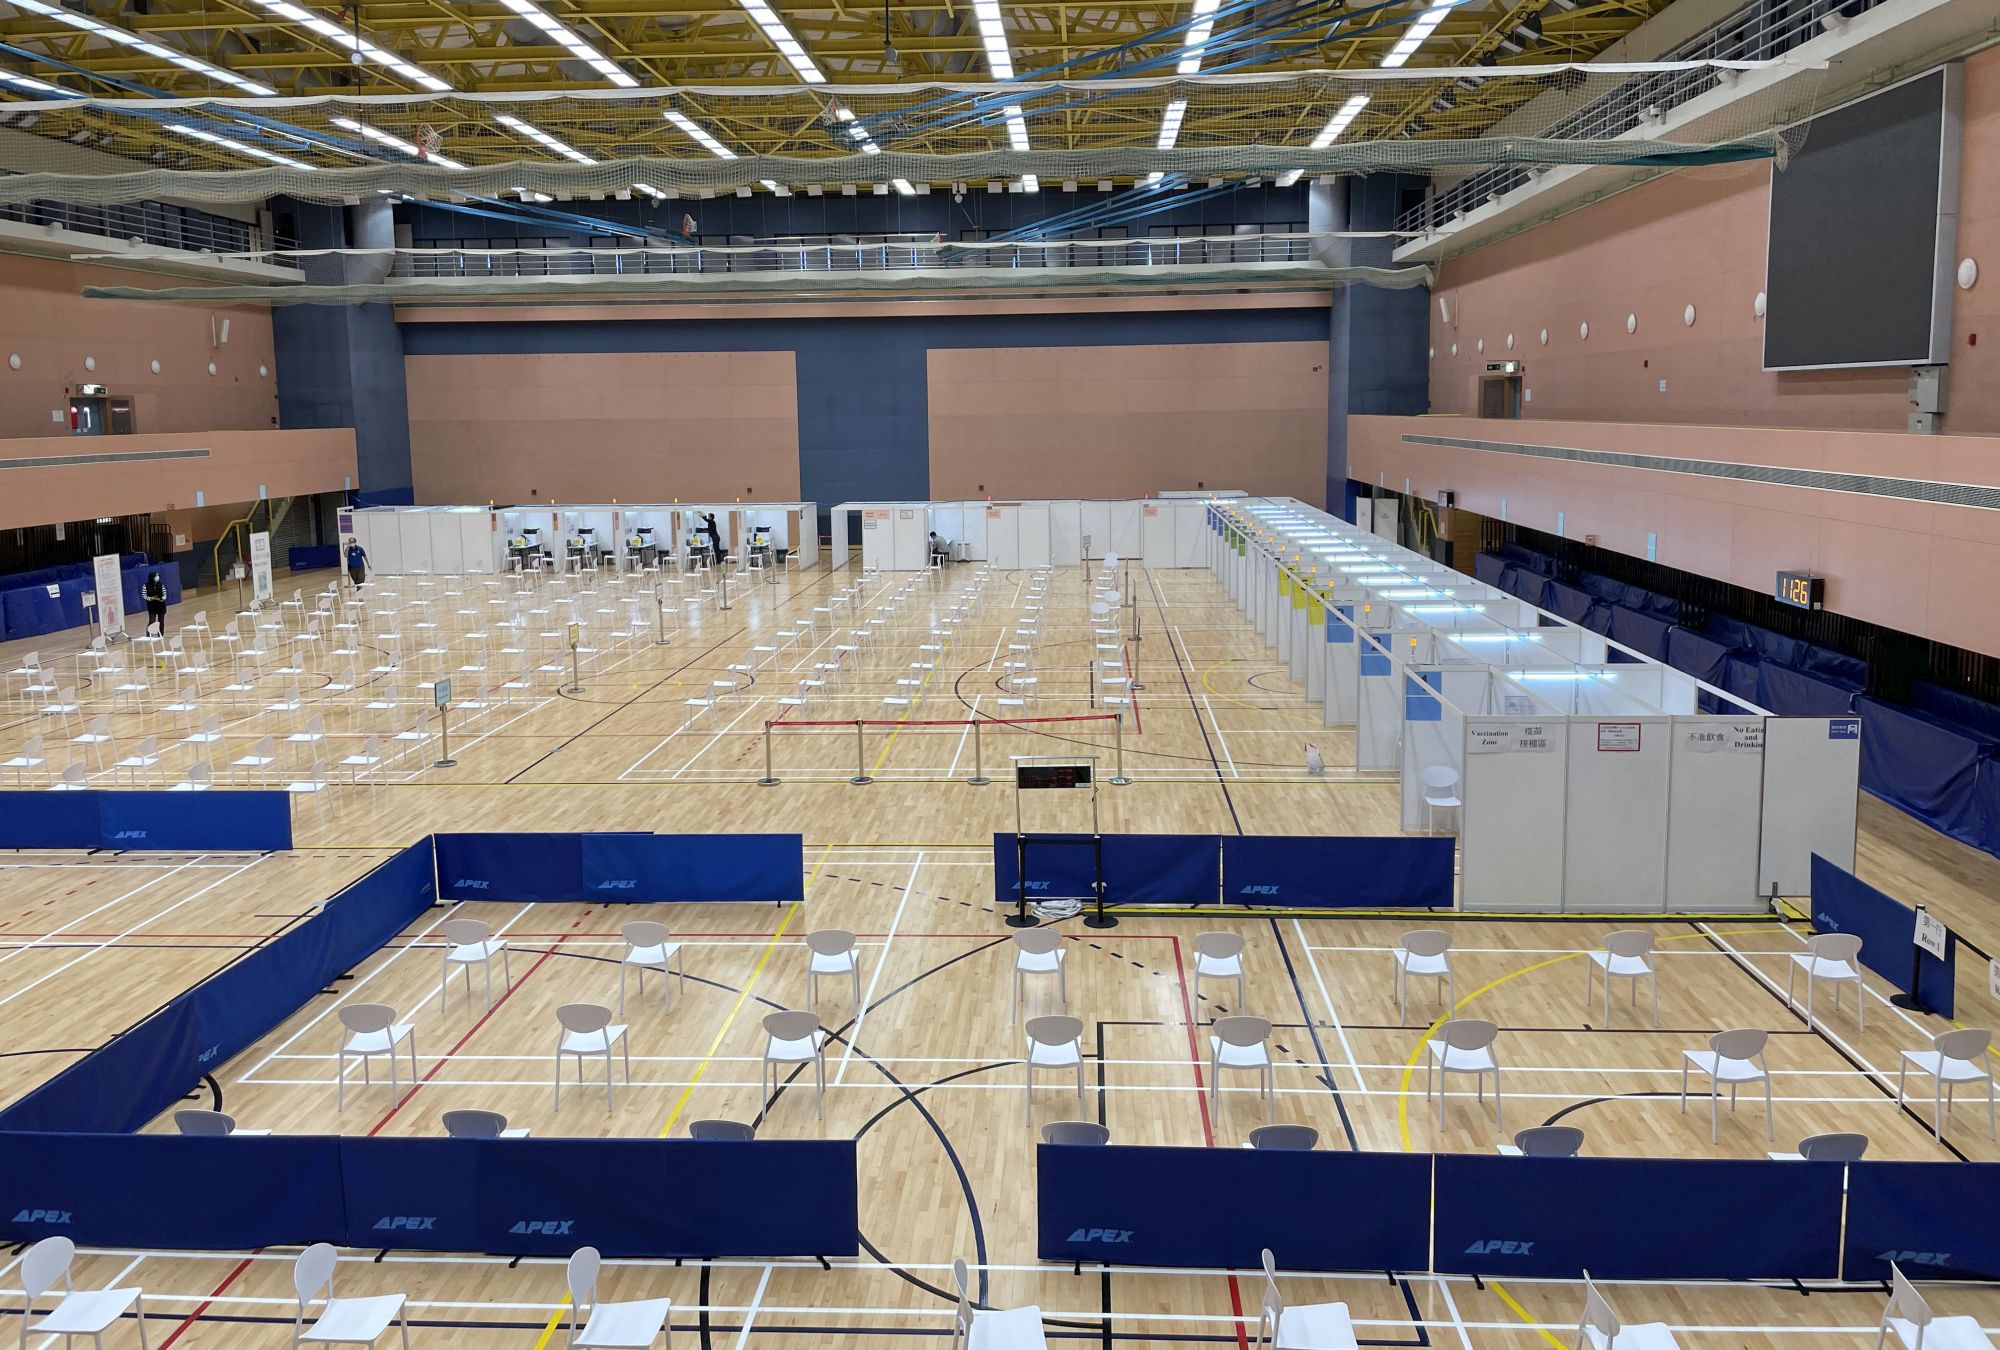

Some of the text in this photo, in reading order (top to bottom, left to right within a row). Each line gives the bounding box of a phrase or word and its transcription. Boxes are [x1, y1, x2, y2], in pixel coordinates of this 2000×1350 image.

[114, 831, 148, 839] APEX
[454, 879, 490, 890] APEX
[598, 879, 637, 889] APEX
[1012, 881, 1051, 890] APEX
[1240, 885, 1280, 895] APEX
[1921, 932, 1936, 947] Row
[12, 1209, 73, 1224] APEX
[372, 1216, 437, 1231] APEX
[509, 1220, 575, 1235] APEX
[1067, 1228, 1134, 1243] APEX
[1465, 1240, 1535, 1256] APEX
[1874, 1250, 1951, 1266] APEX
